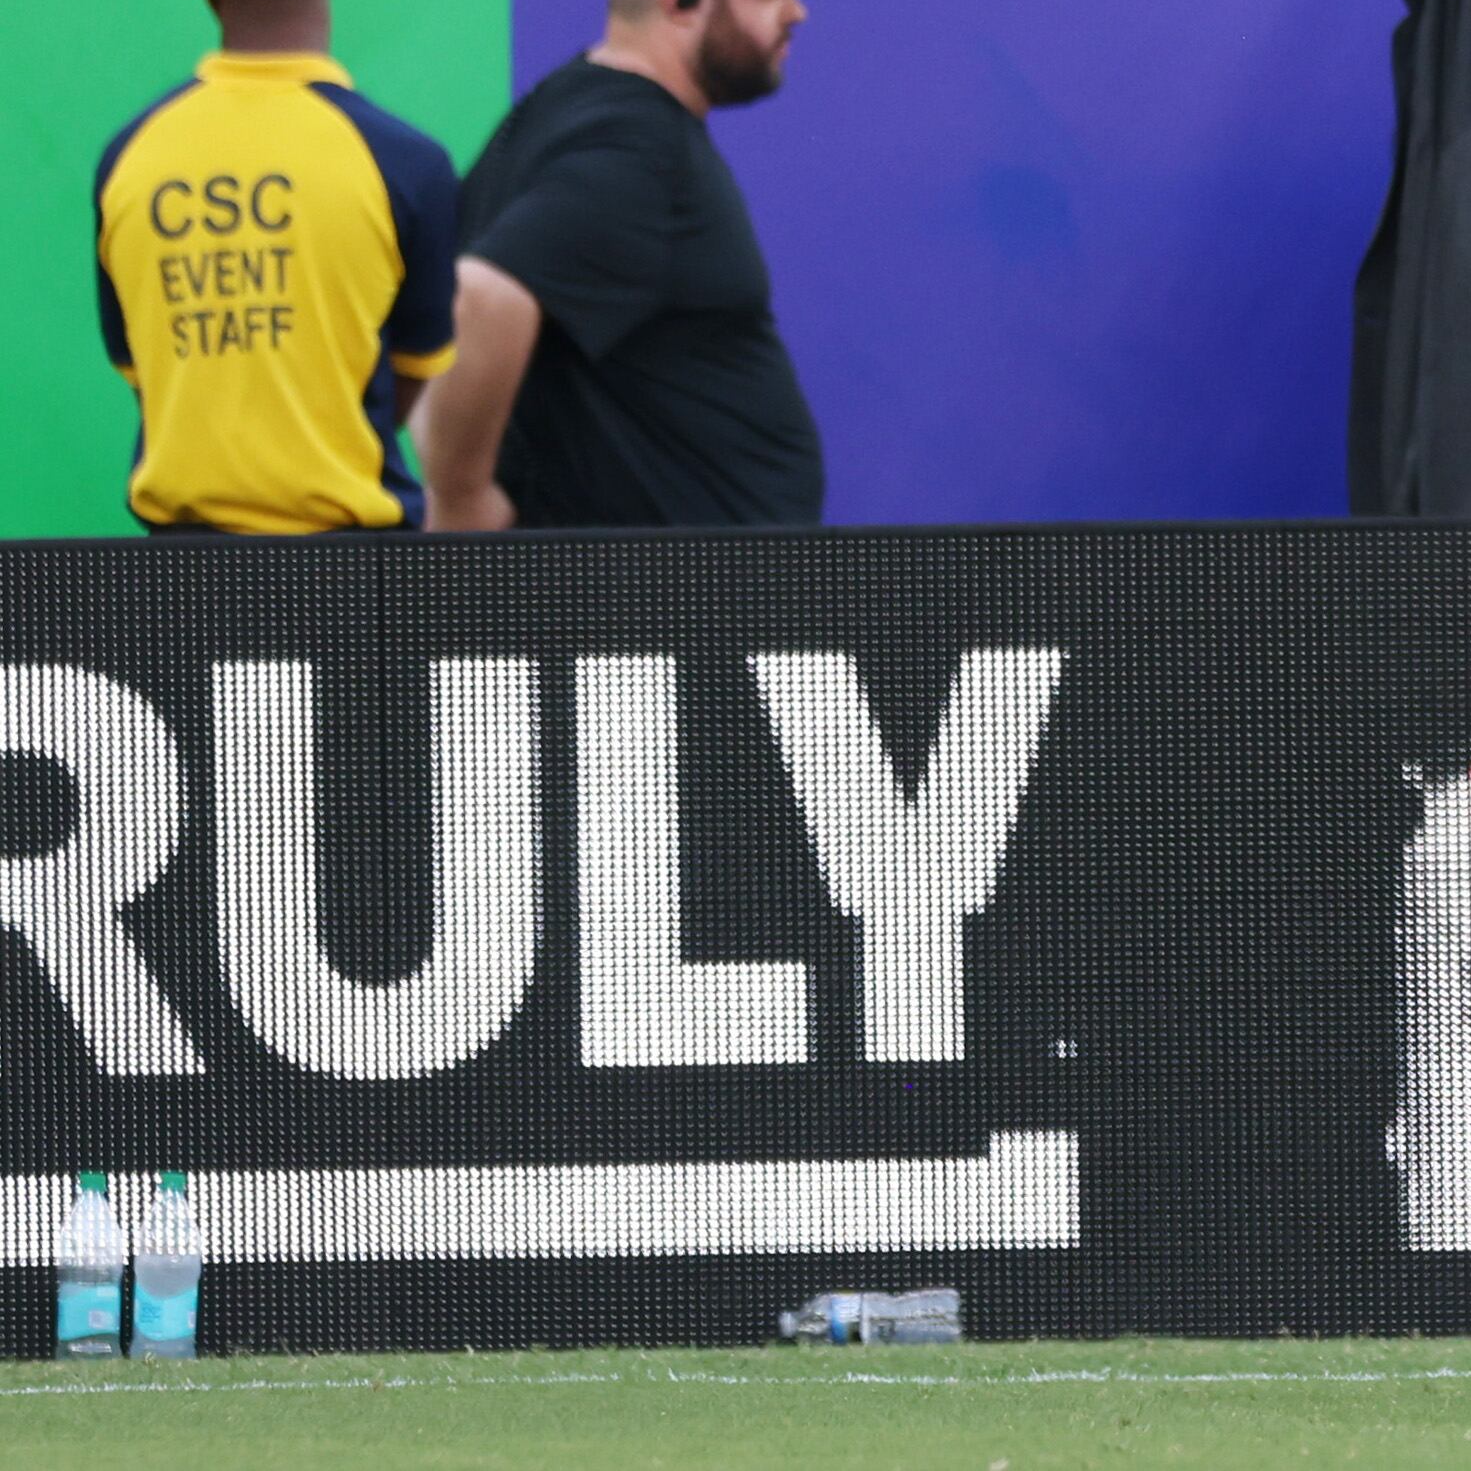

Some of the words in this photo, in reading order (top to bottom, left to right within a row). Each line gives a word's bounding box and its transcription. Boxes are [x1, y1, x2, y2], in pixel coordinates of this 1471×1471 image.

[151, 174, 292, 239] CSC
[159, 247, 294, 305] EVENT
[171, 307, 293, 359] STAFF
